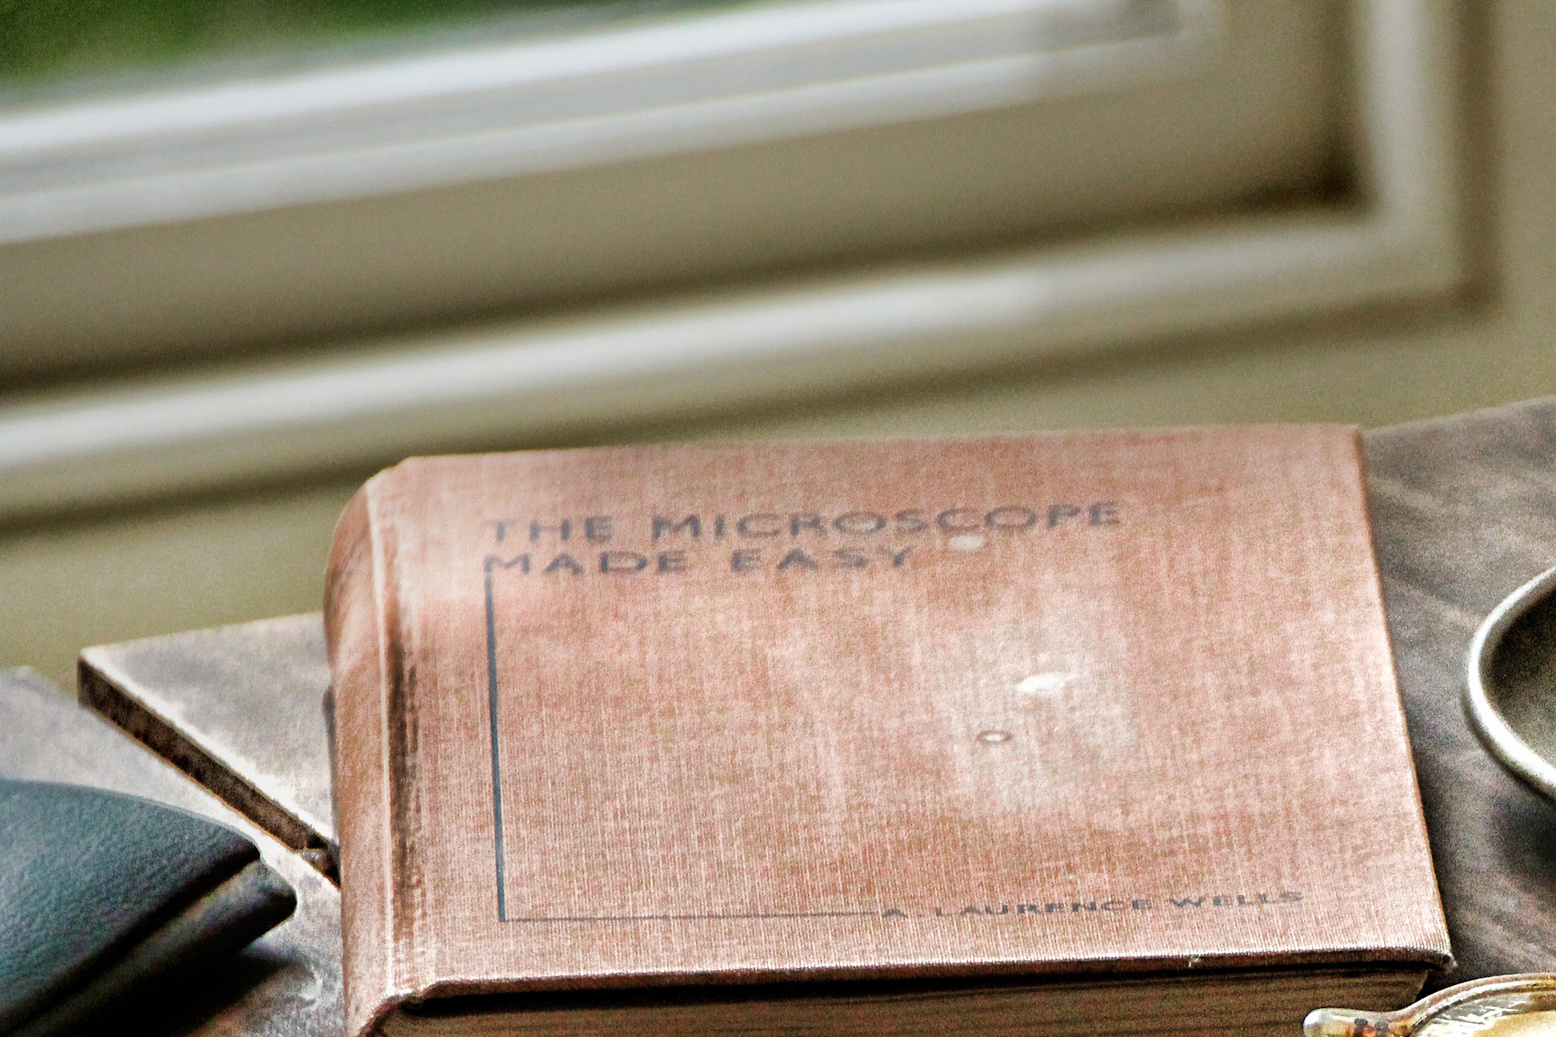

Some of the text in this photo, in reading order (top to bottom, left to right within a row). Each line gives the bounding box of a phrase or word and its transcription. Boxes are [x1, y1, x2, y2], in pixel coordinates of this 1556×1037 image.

[484, 501, 1120, 543] THE MICROSCOPE
[483, 547, 909, 575] MADE EASY
[935, 899, 1153, 918] LAURENCE
[1172, 889, 1304, 908] WELLS
